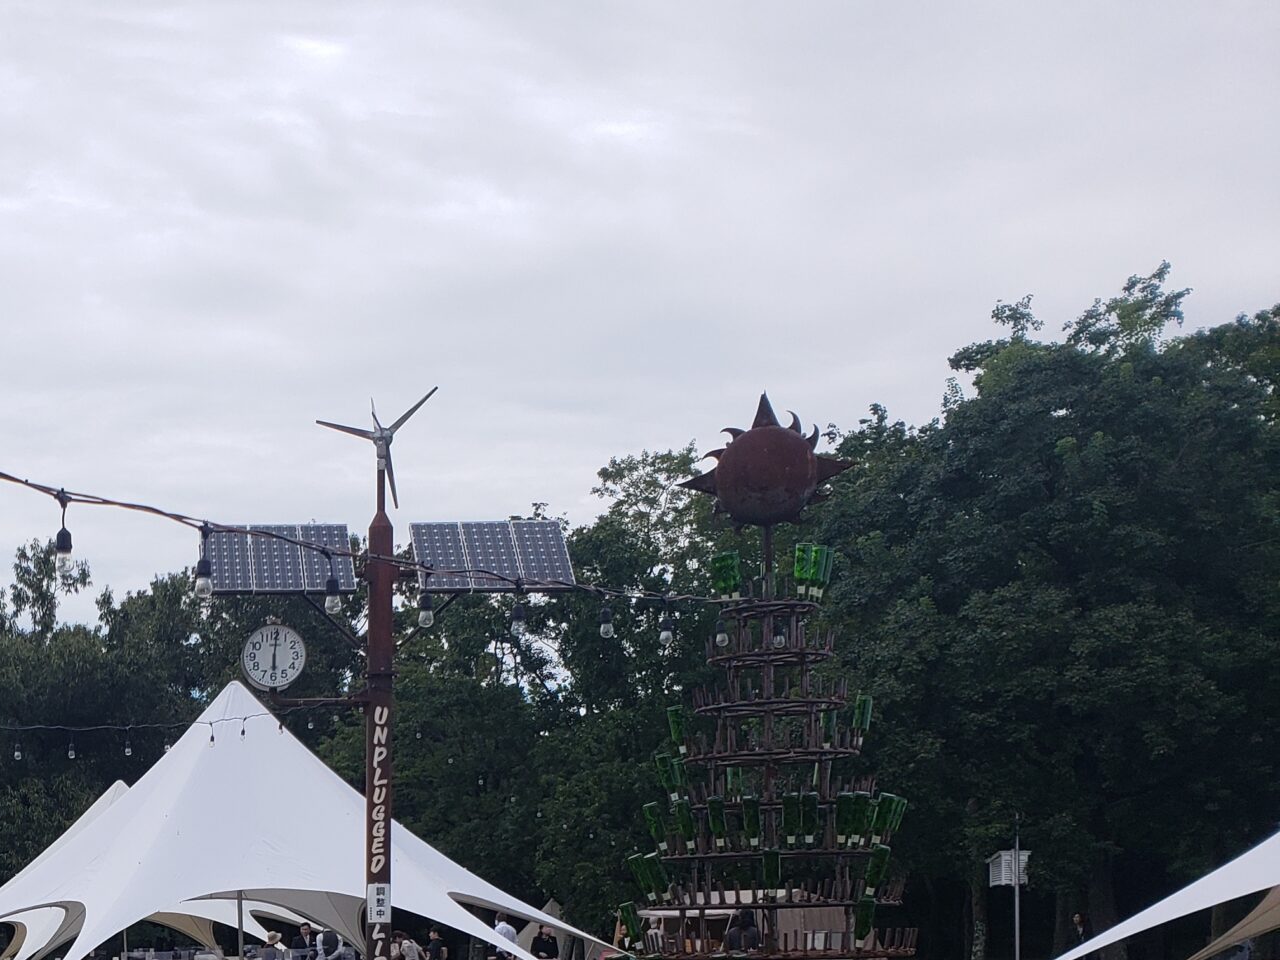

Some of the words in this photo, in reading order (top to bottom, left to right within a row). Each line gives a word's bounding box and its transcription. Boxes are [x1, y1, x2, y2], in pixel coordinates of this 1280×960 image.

[260, 632, 268, 643] 11
[270, 630, 280, 641] 12
[250, 641, 262, 651] 10
[289, 640, 297, 650] 2
[248, 652, 256, 662] 9
[291, 651, 299, 661] 3
[252, 661, 260, 671] 8
[288, 661, 296, 671] 4
[260, 669, 267, 679] 7
[269, 672, 277, 682] 6
[280, 669, 288, 679] 5
[370, 705, 389, 874] UNPLUGGED
[375, 886, 385, 919] 調整中
